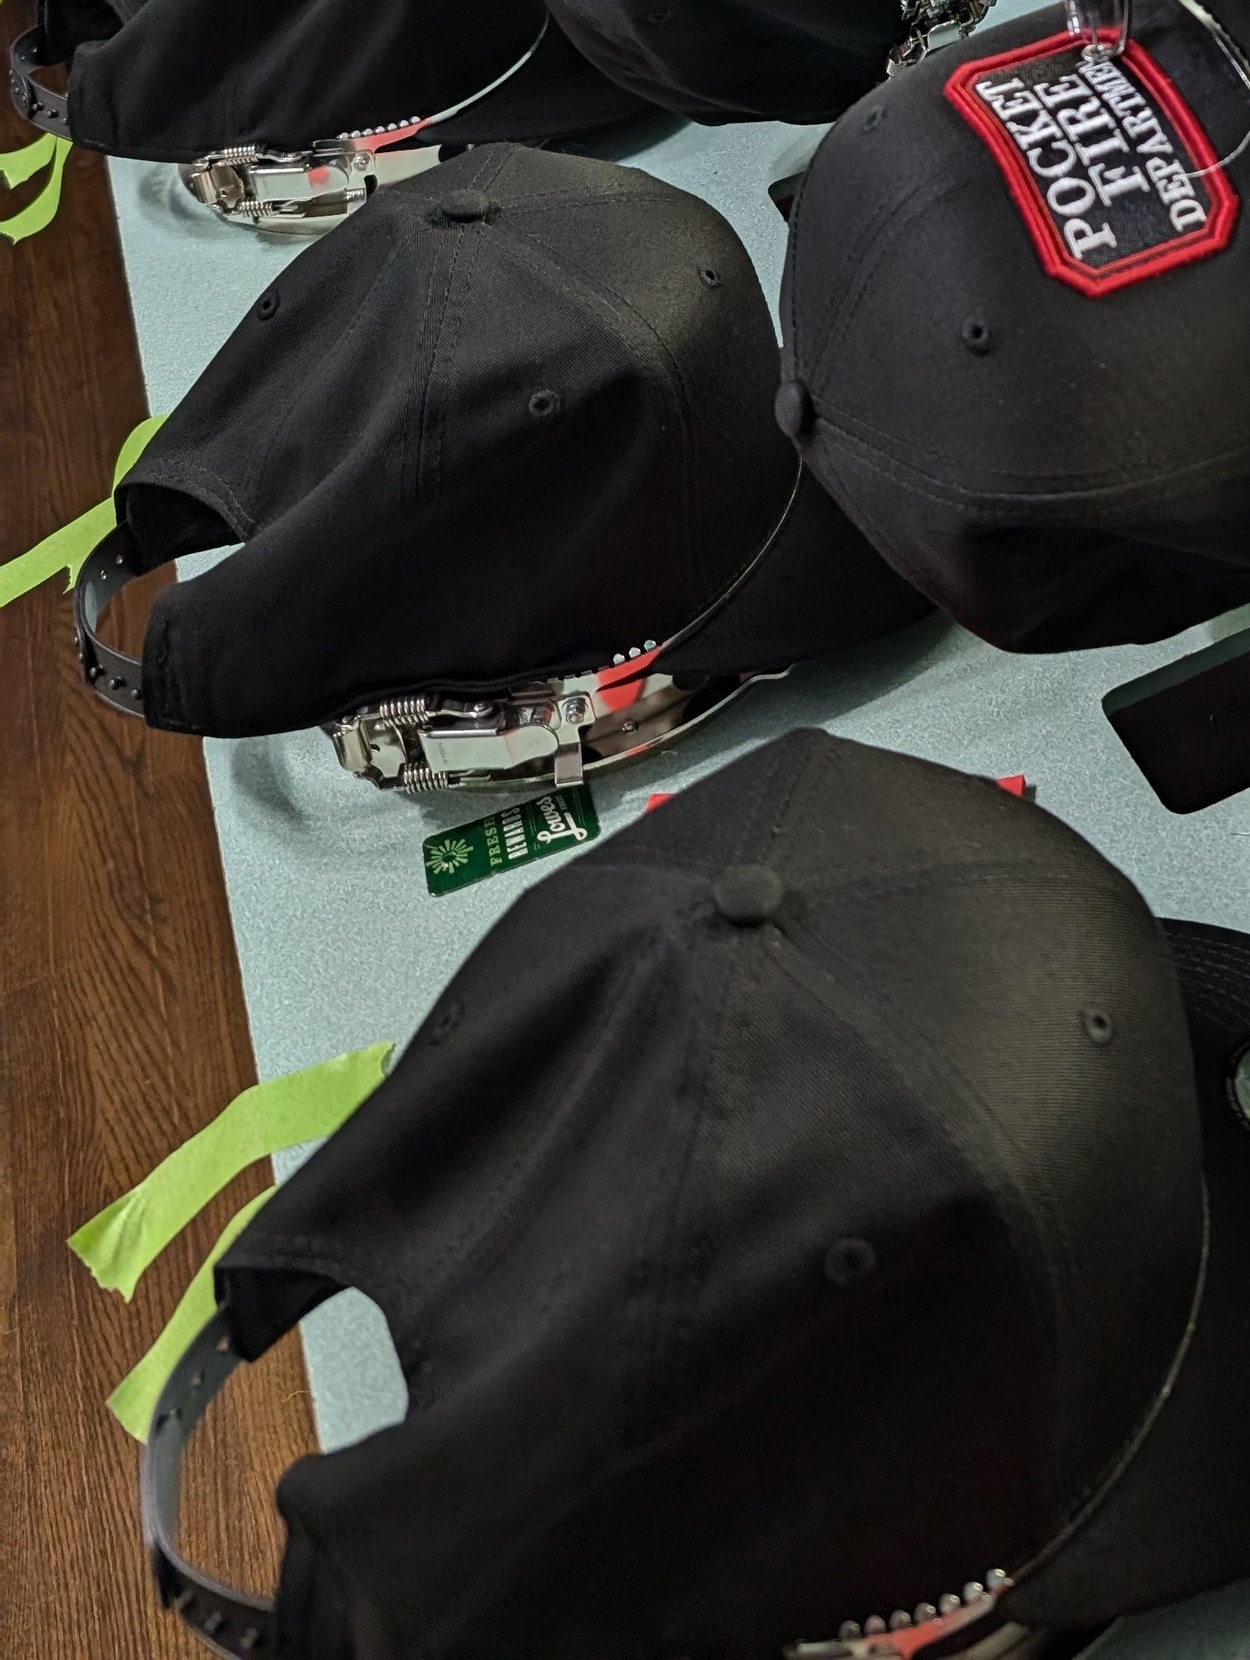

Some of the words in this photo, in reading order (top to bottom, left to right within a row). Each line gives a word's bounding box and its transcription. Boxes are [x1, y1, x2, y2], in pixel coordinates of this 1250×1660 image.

[1033, 74, 1149, 207] FIRE
[974, 77, 1117, 260] POCKET
[484, 815, 503, 867] FRESH
[501, 807, 529, 860] REWARDS
[536, 796, 588, 844] Lowes
